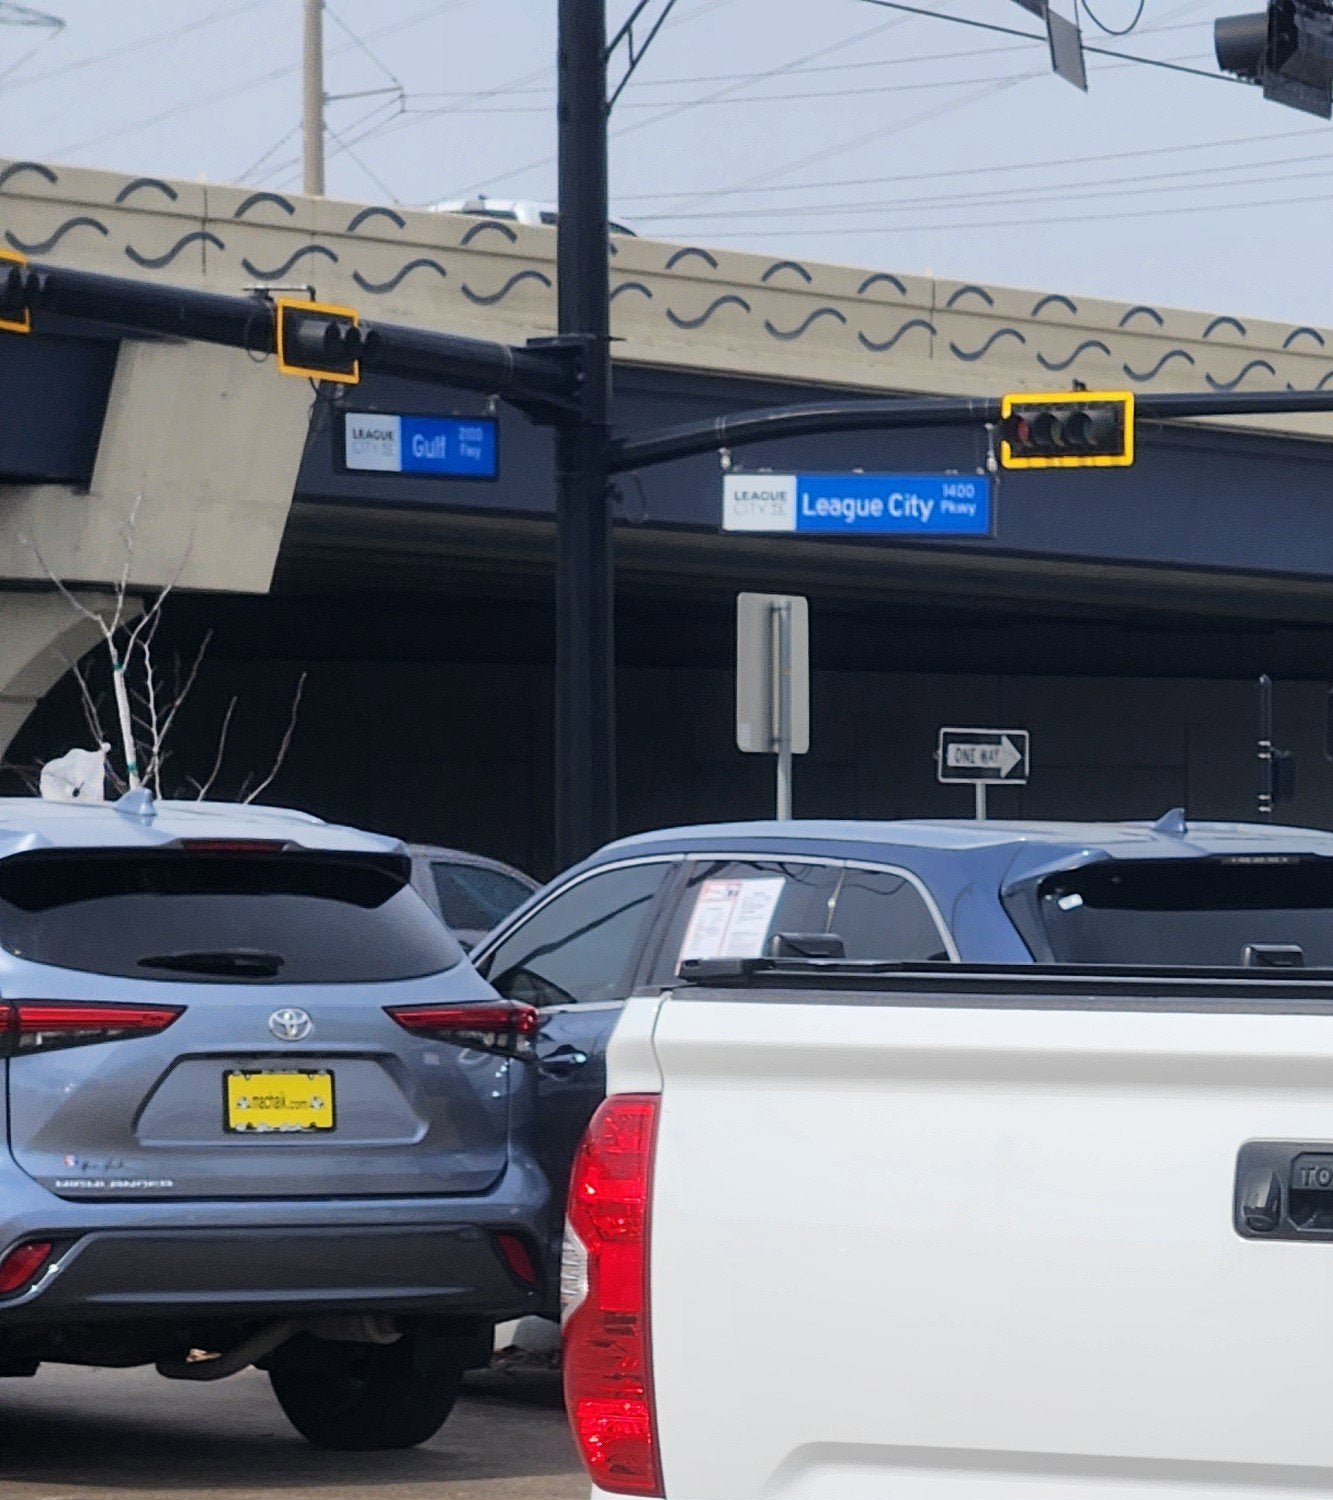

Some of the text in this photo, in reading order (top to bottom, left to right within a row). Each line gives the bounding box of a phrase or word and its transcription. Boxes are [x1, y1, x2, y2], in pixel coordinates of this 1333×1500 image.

[352, 427, 393, 440] LEAGUE
[412, 433, 446, 458] Gulf
[734, 490, 787, 501] LEAGUE
[942, 483, 975, 498] 1400
[802, 492, 934, 523] League City
[941, 499, 976, 517] Pkwy
[954, 747, 1000, 764] ONE WAY
